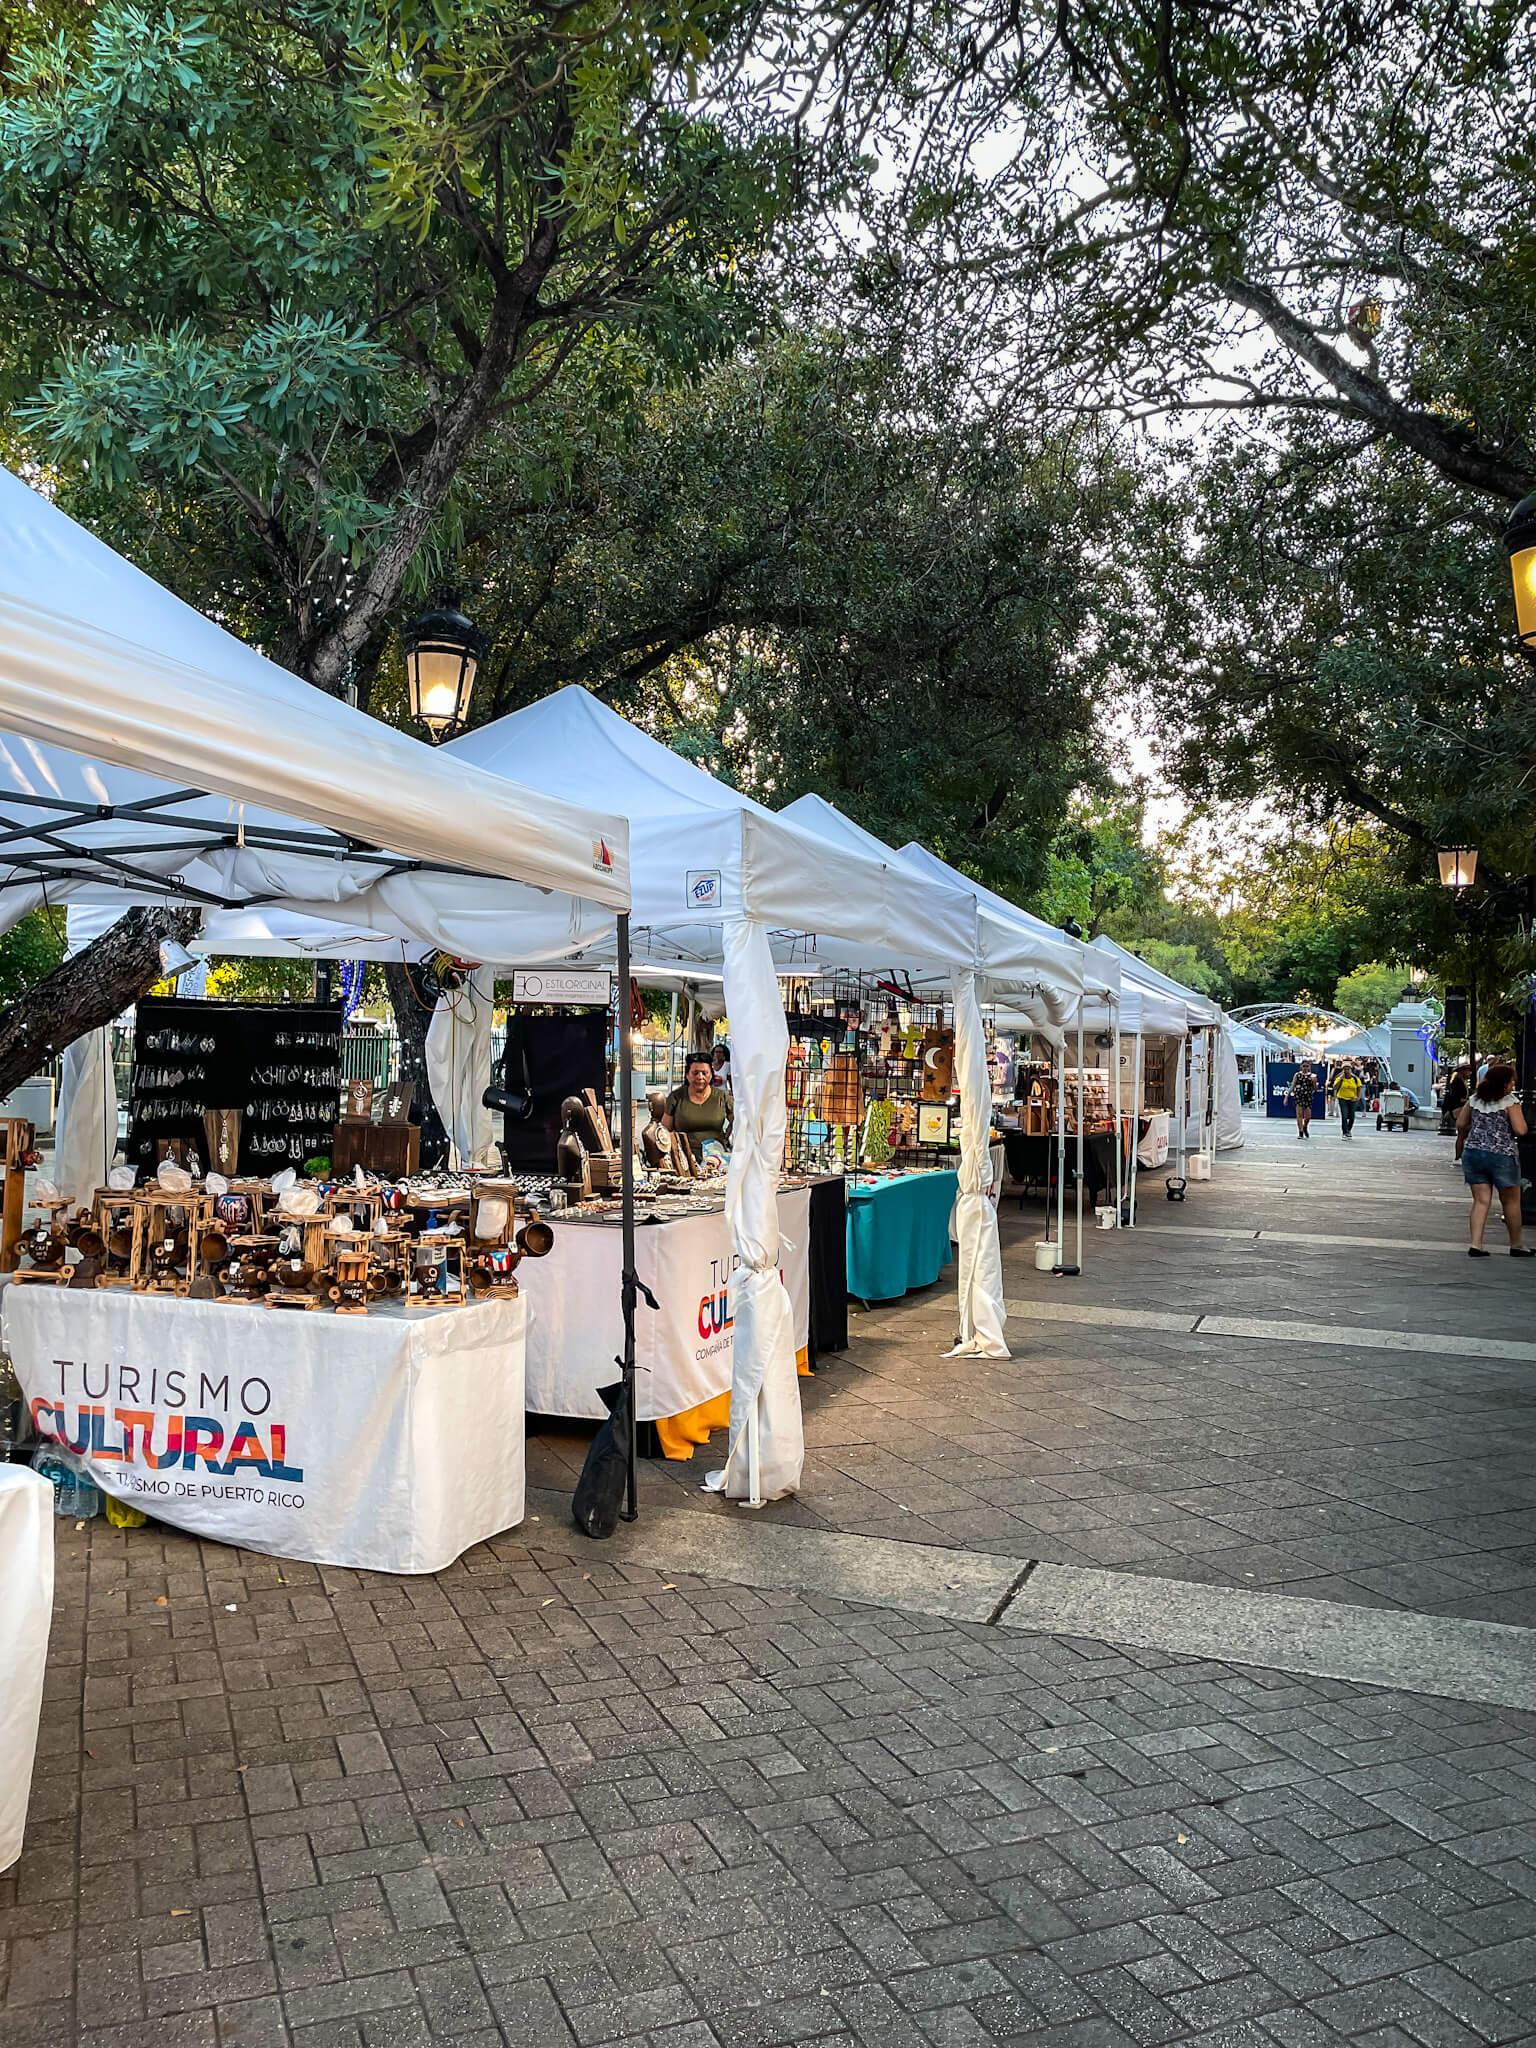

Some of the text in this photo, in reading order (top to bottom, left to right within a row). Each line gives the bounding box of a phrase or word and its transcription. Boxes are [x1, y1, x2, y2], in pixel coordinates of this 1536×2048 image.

[52, 1359, 271, 1416] TURISMO
[31, 1396, 304, 1483] CULTURAL
[174, 1481, 198, 1497] DE
[201, 1484, 264, 1504] PUERTO
[267, 1491, 305, 1509] RICO
